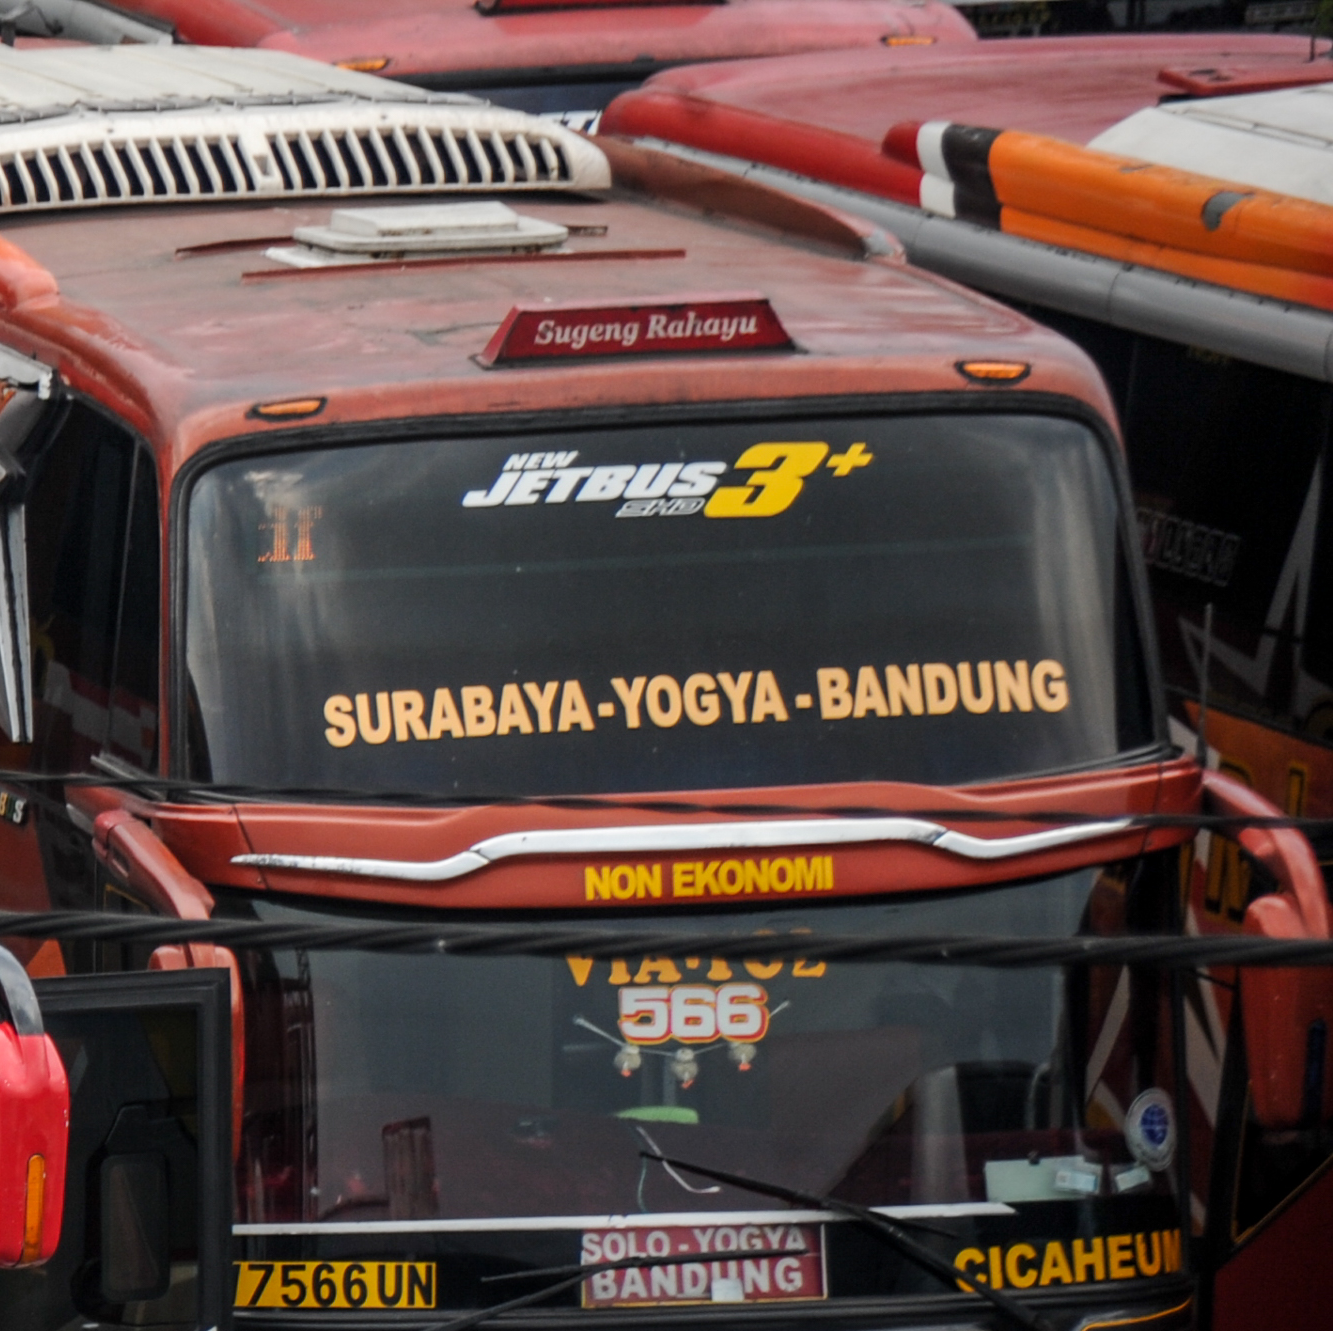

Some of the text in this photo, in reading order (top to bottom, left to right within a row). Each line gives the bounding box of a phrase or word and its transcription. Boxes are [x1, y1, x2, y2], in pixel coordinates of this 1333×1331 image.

[535, 311, 757, 350] Sugeng Rahayu
[503, 450, 579, 471] NEW
[462, 461, 727, 508] JETBUS
[584, 855, 834, 901] NON EKONOMI
[618, 982, 769, 1046] 566
[582, 1230, 671, 1263] SOLO
[692, 1224, 807, 1253] YOGYA
[247, 1262, 433, 1307] 7566 UN
[591, 1257, 804, 1300] BANDUNG
